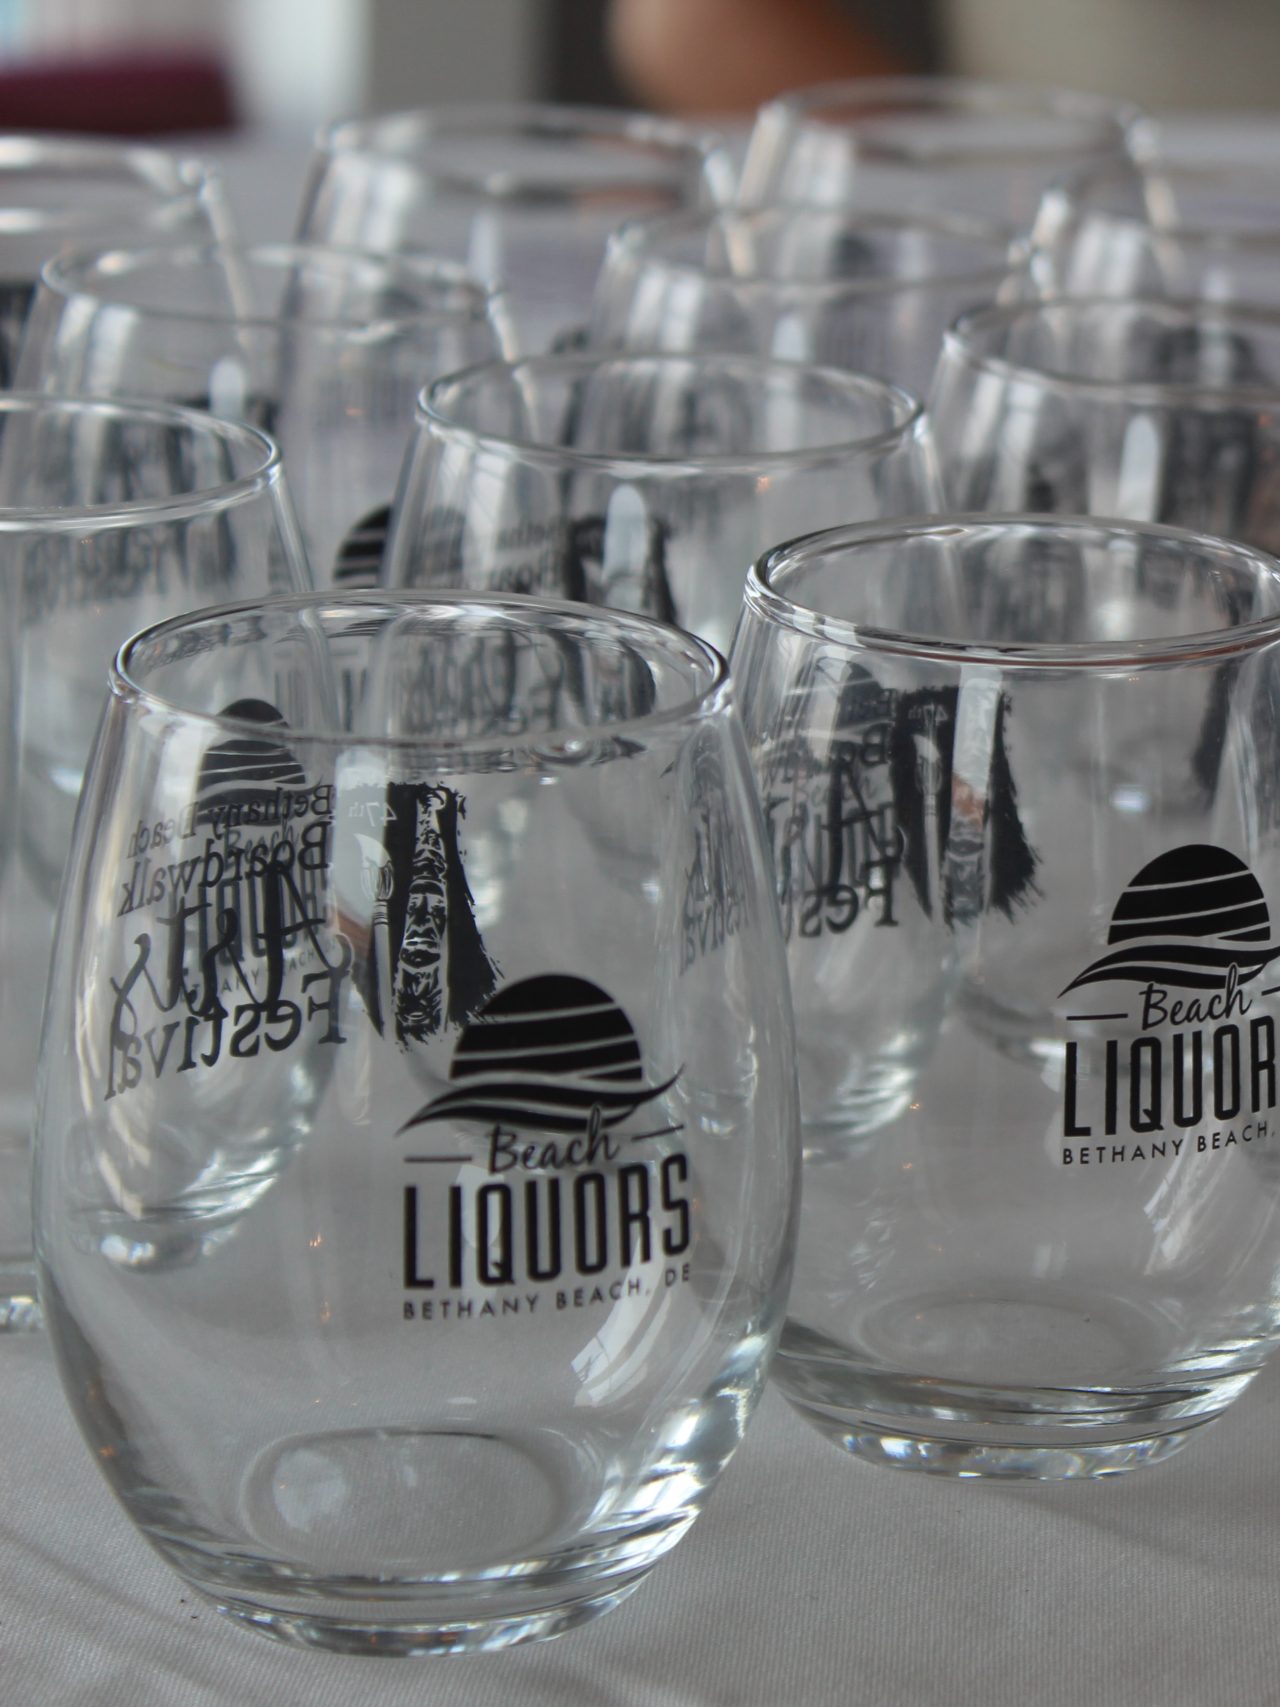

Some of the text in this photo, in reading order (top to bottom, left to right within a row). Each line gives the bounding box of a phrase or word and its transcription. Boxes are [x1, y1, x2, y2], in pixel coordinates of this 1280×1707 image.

[1139, 963, 1253, 1031] Beach
[486, 1102, 621, 1175] Beach
[1063, 1139, 1184, 1165] BETHANY
[1197, 1121, 1275, 1152] BEACH,
[404, 1153, 690, 1288] LIQUORS
[403, 1296, 539, 1320] BETHANY
[665, 1263, 691, 1287] DE
